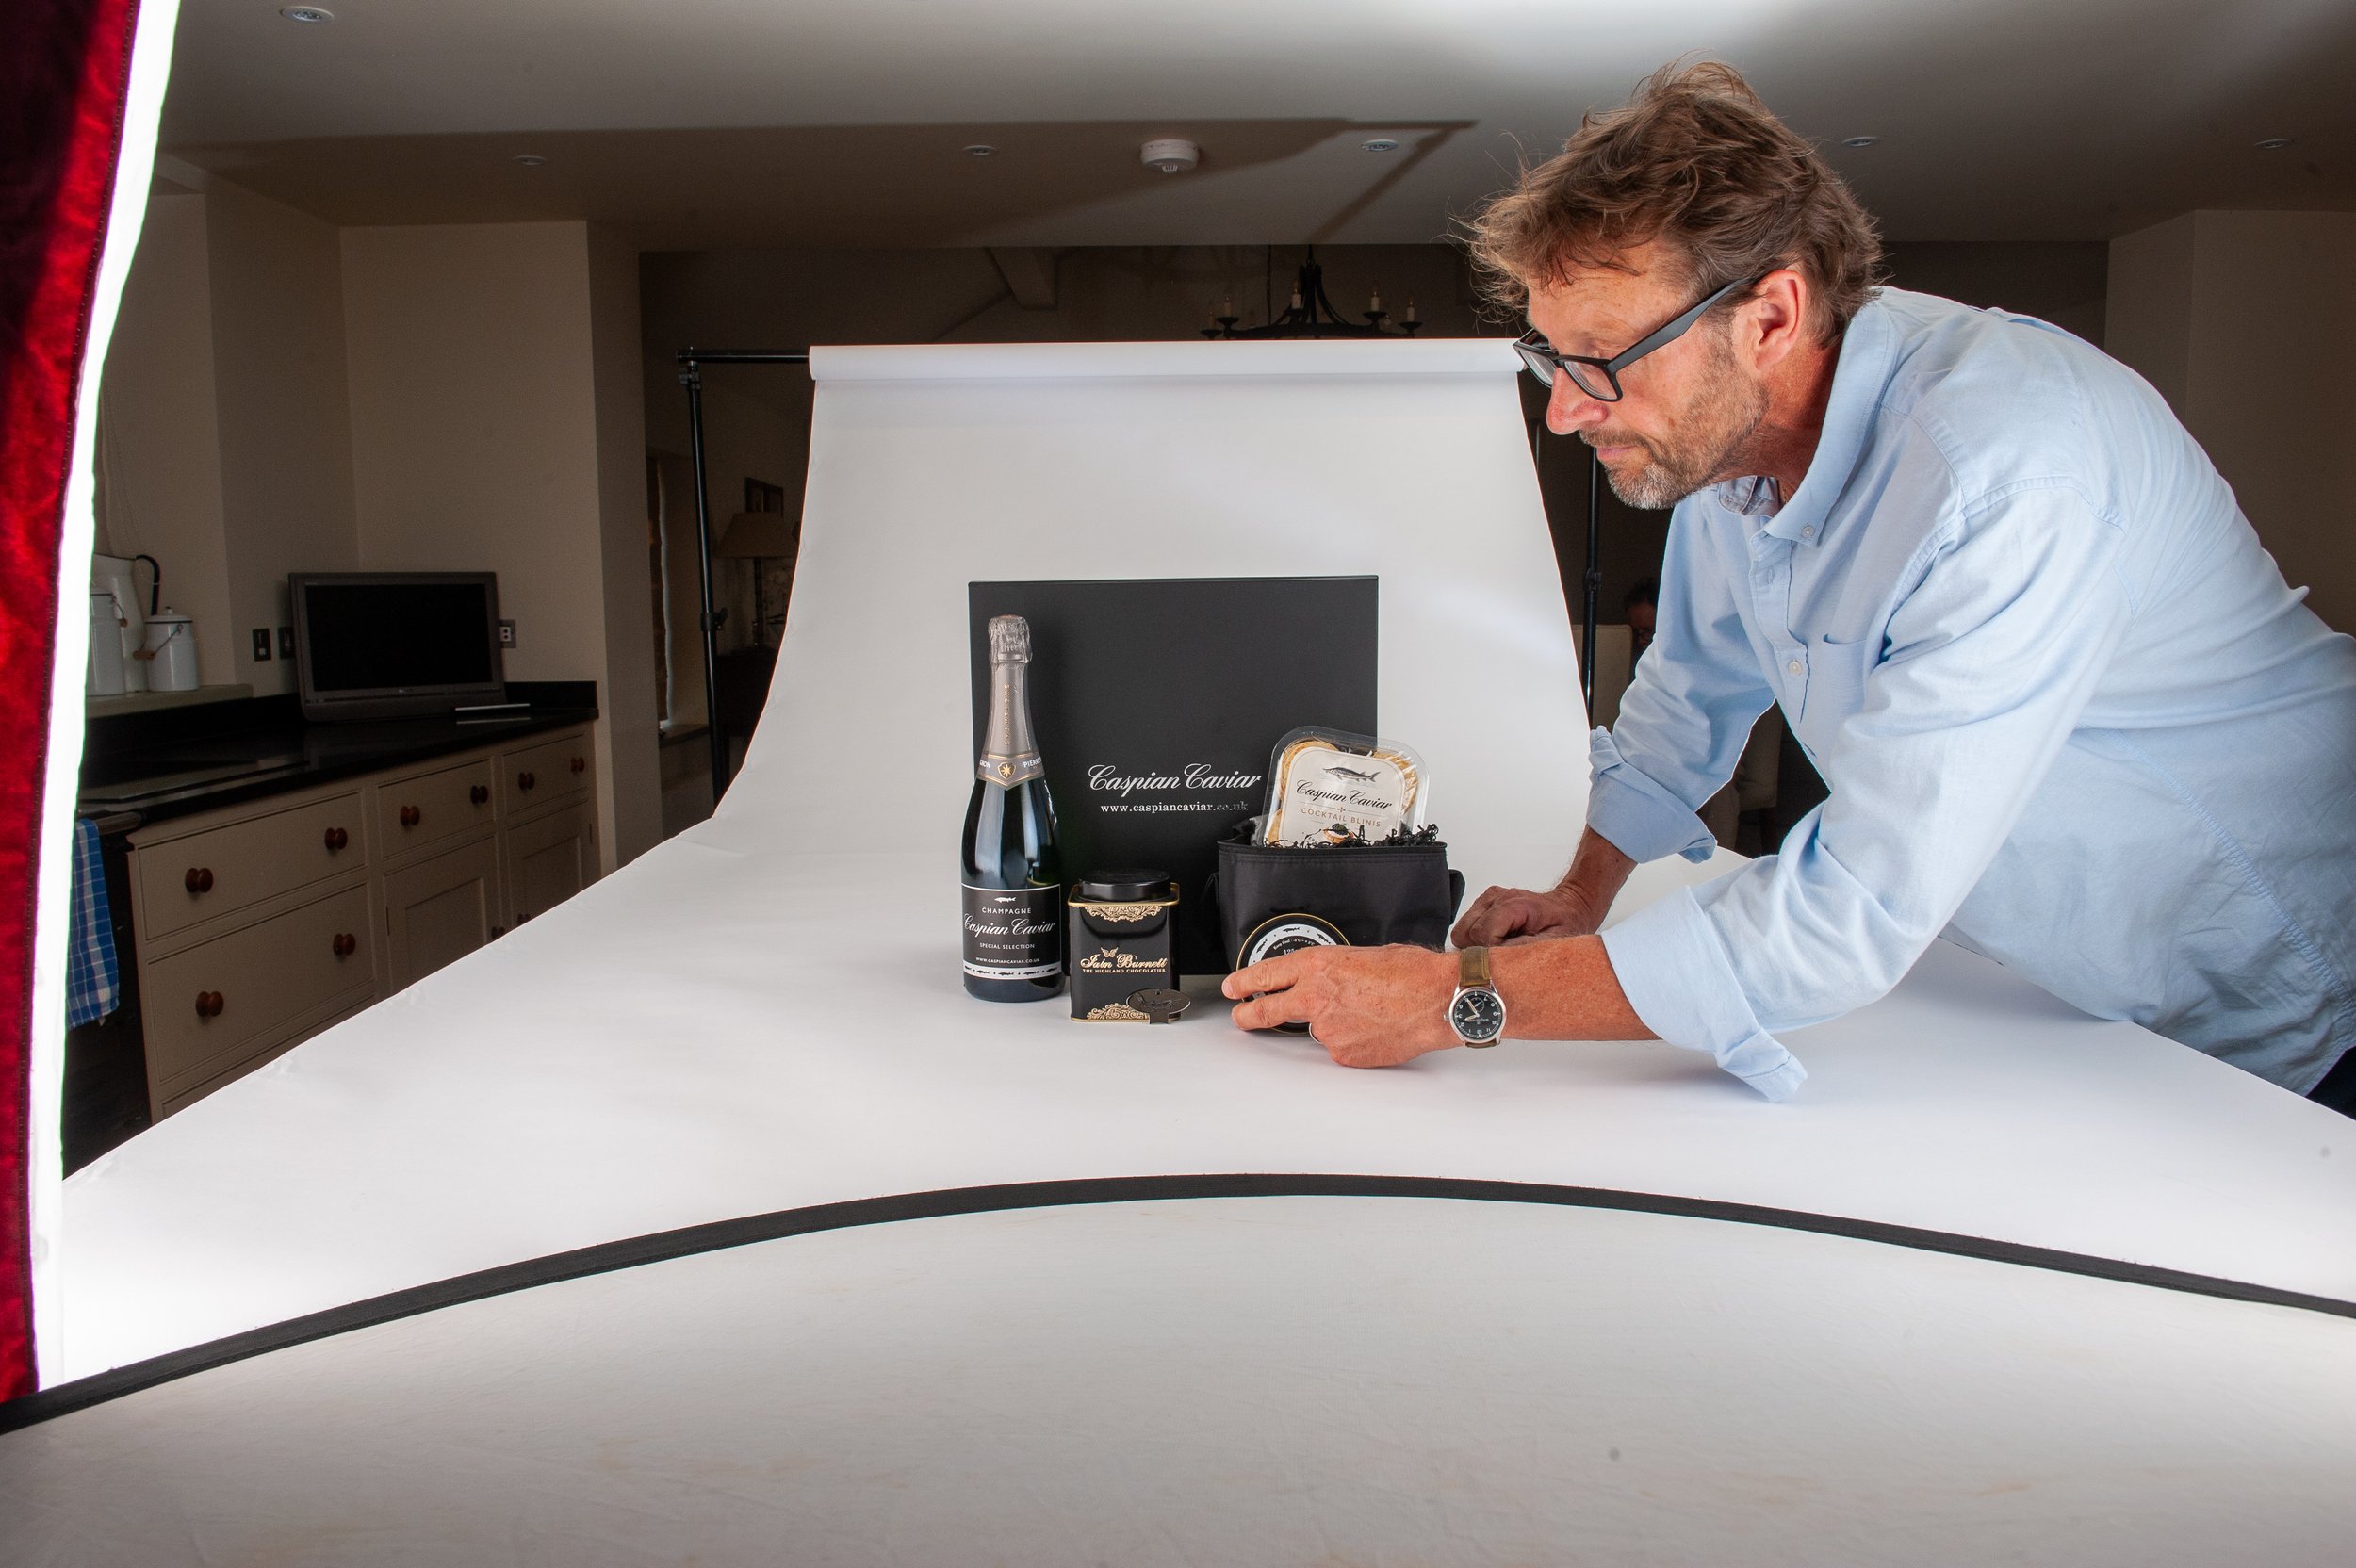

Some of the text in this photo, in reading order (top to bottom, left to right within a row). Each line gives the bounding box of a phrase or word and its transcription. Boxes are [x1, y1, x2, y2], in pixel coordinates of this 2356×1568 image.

[1088, 763, 1262, 798] Caspian Caviar
[1296, 780, 1393, 809] Caspian Caviar
[1101, 801, 1249, 814] www.caspiancaviar.co.uk
[1301, 808, 1382, 827] COCKTAIL BLINIS
[963, 913, 1055, 938] Caspian Caviar
[1080, 953, 1169, 969] Iain Burnett
